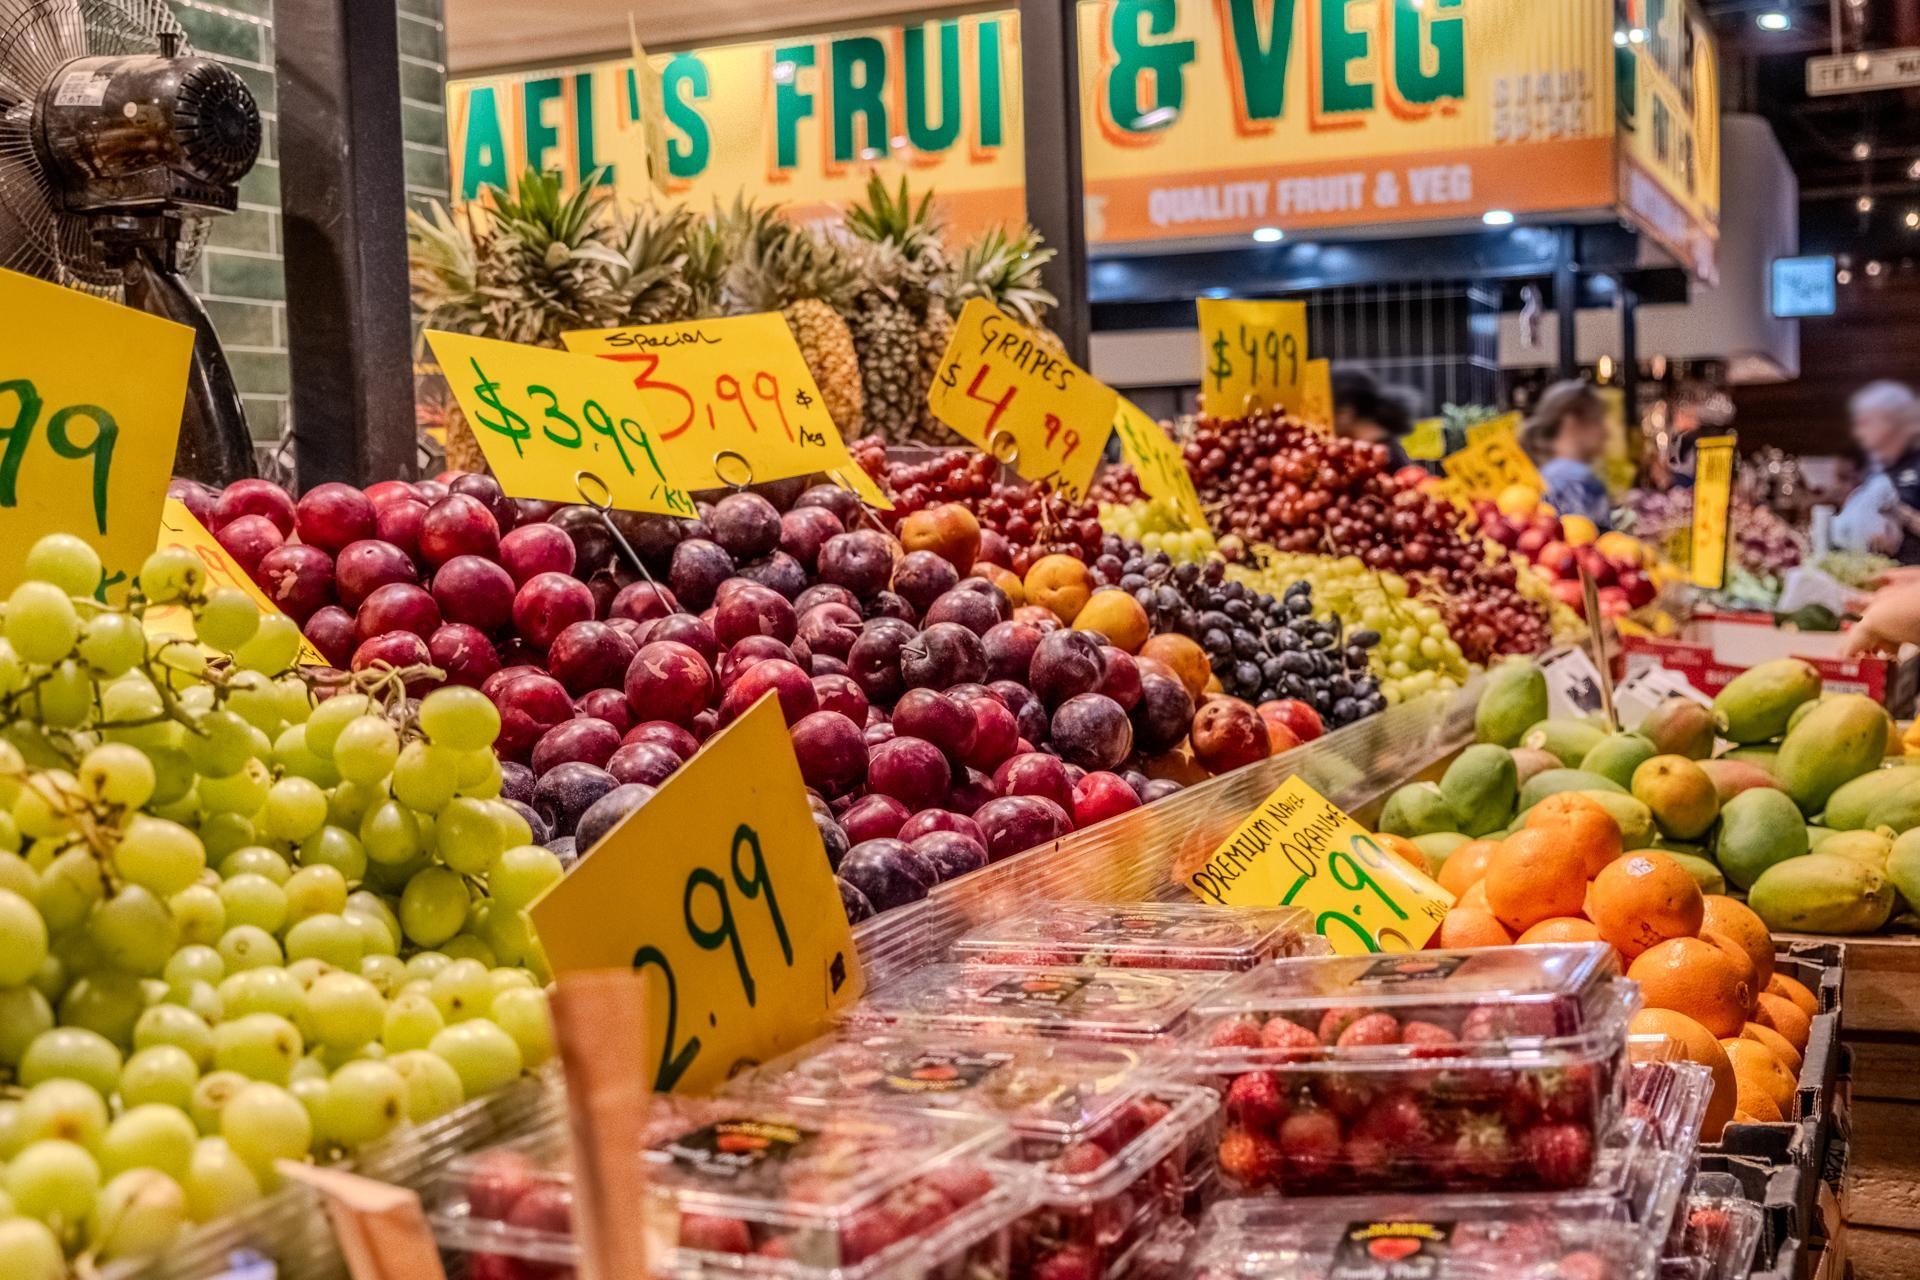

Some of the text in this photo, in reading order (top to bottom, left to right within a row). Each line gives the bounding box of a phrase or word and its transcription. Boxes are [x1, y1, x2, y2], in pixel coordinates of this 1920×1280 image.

[1108, 0, 1195, 132] &
[1222, 0, 1466, 120] VEG
[1148, 181, 1270, 227] QUALITY
[1276, 172, 1366, 215] FRUIT
[1374, 171, 1399, 208] &
[1407, 164, 1473, 205] VEG
[980, 315, 1076, 391] GRAPES
